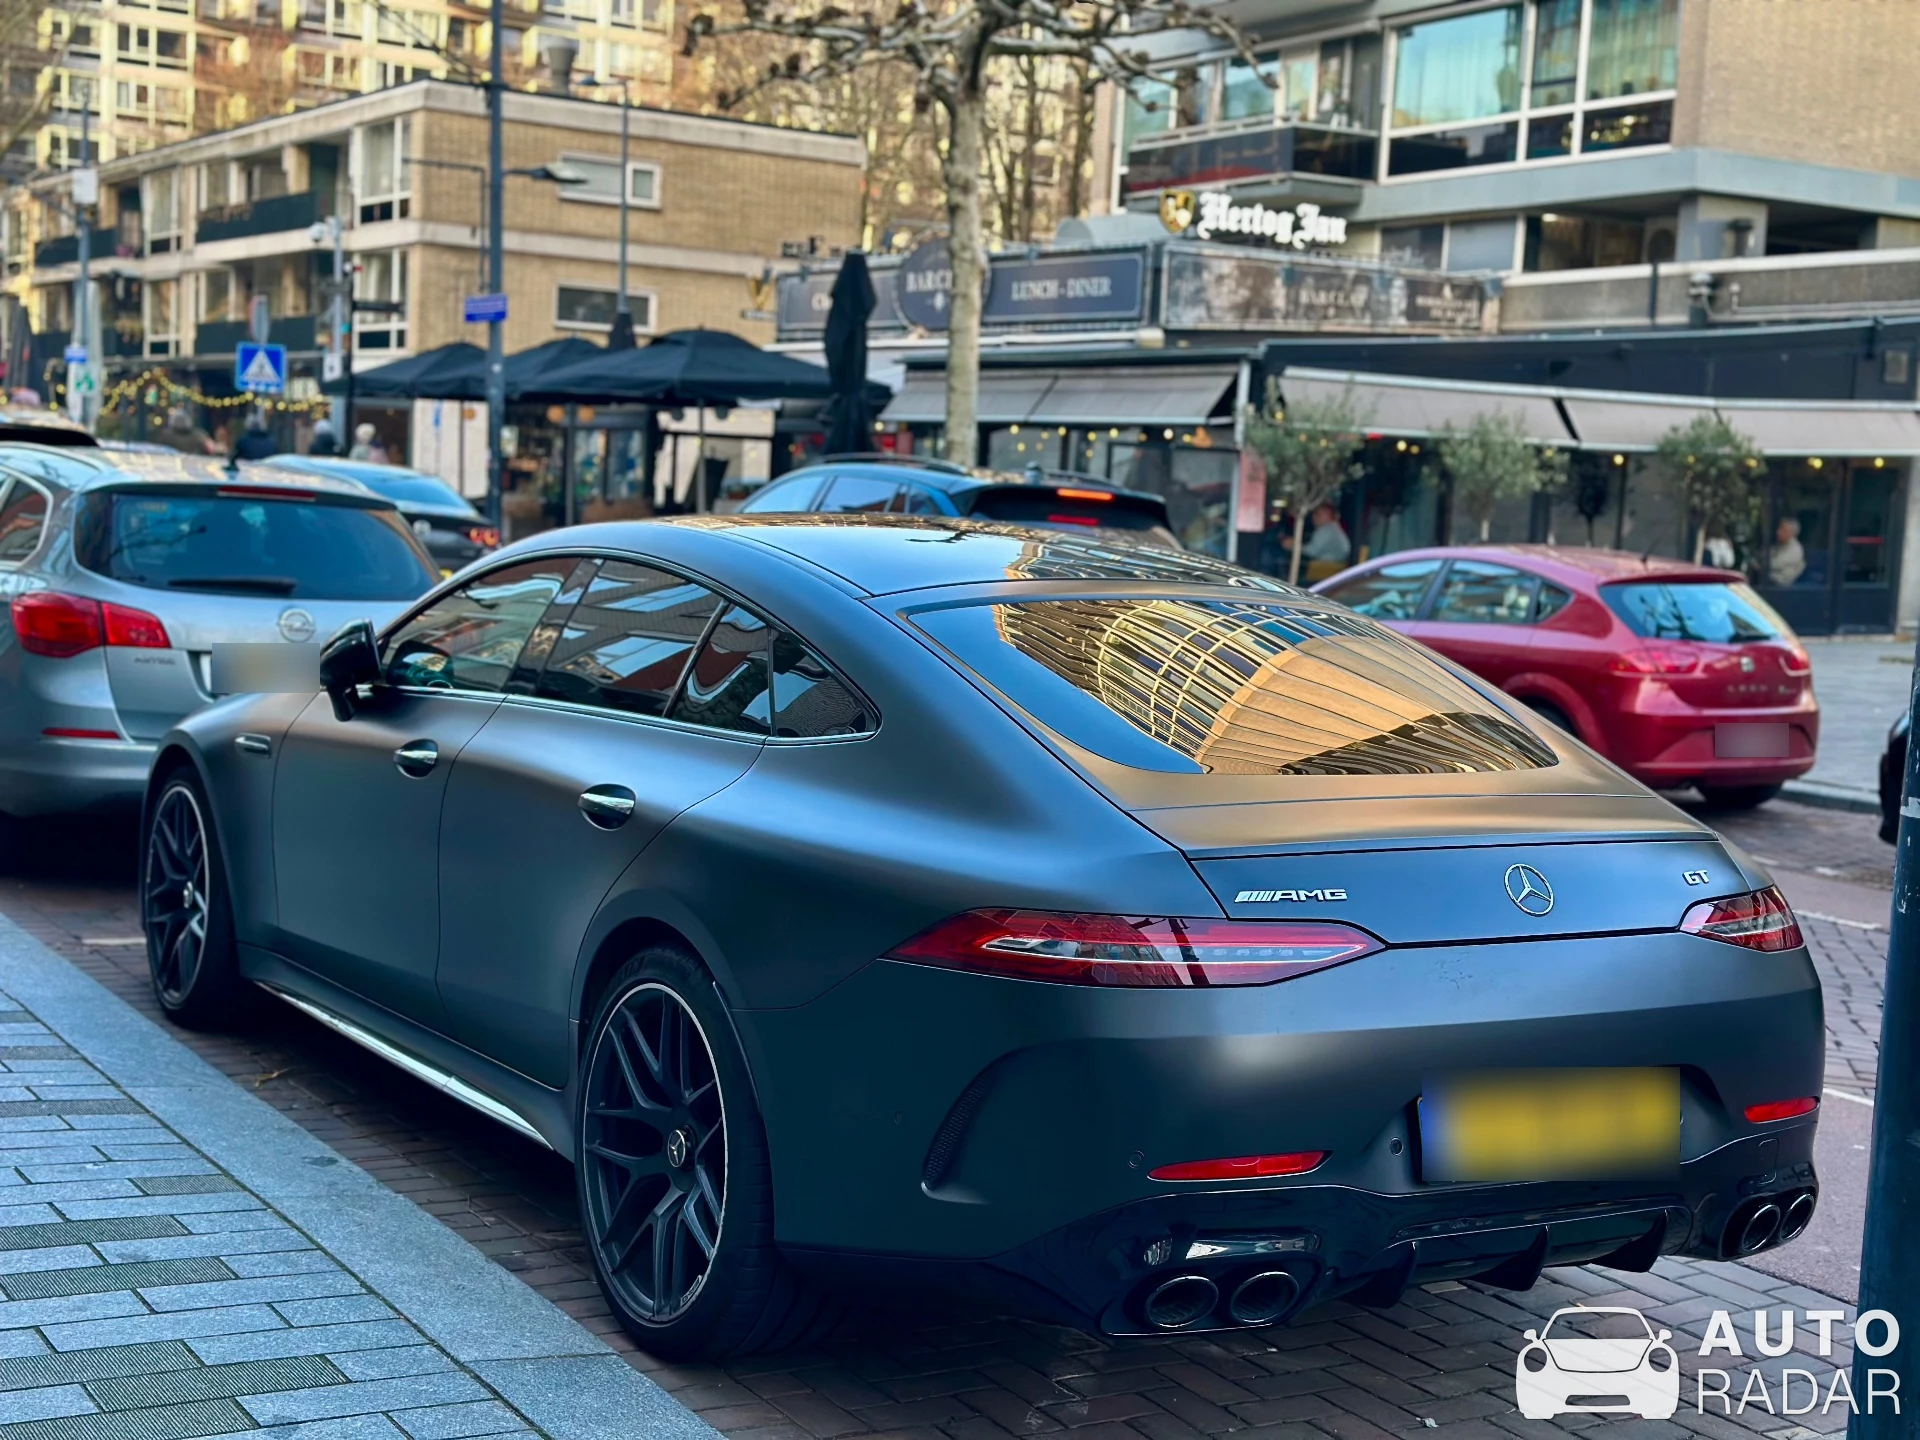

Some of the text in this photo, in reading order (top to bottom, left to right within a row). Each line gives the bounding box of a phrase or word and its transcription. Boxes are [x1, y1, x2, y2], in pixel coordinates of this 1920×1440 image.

[1197, 191, 1295, 244] Hertog
[1011, 279, 1059, 301] LUNCH
[1683, 869, 1709, 886] GT
[1272, 889, 1348, 903] AMG
